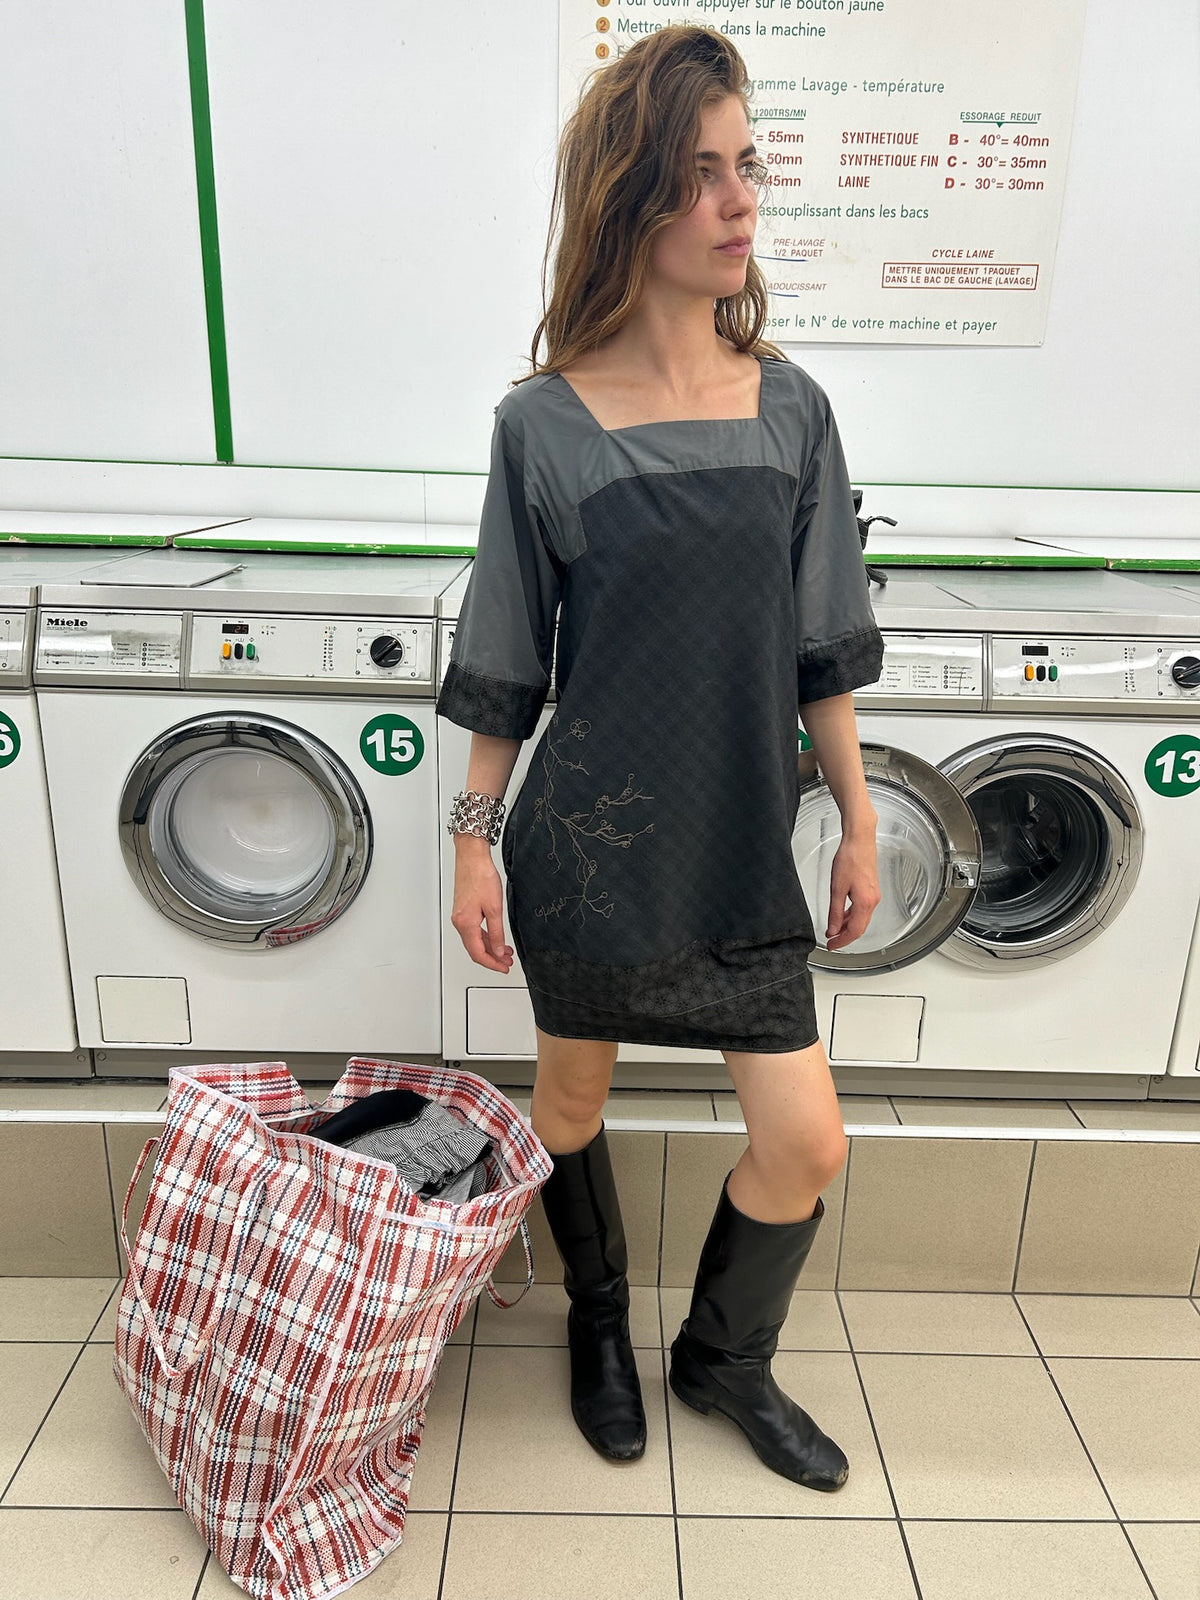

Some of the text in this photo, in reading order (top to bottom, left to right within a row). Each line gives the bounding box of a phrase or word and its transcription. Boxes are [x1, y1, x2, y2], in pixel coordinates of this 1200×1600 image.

[696, 0, 750, 13] appuyer
[755, 0, 775, 9] sur
[780, 0, 792, 10] le
[796, 0, 844, 10] bouton
[847, 0, 885, 15] jaune
[617, 18, 663, 34] Mettre
[720, 20, 751, 36] dans
[756, 20, 767, 36] la
[771, 21, 826, 37] machine
[802, 77, 848, 95] Lavage
[862, 78, 945, 97] température
[960, 112, 1042, 122] ESSORAGE REDUIT
[768, 131, 804, 143] 55mn
[842, 131, 919, 145] SYNTHETIQUE
[949, 134, 959, 145] B
[1013, 134, 1050, 147] 40mn
[767, 153, 803, 165] 50mn
[840, 154, 917, 167] SYNTHETIQUE
[920, 155, 939, 167] FIN
[947, 156, 957, 168] C
[1010, 156, 1047, 169] 35mn
[766, 175, 801, 187] 45mn
[838, 176, 870, 188] LAINE
[945, 177, 955, 189] D
[1008, 178, 1044, 190] 30mn
[845, 204, 875, 218] dans
[879, 204, 896, 218] les
[900, 204, 929, 219] bacs
[773, 238, 826, 247] PRE-LAVAGE
[774, 249, 824, 257] 1/2 PAQUET
[932, 249, 995, 259] CYCLE LAINE
[889, 266, 922, 275] METTRE
[925, 267, 979, 275] UNIQUEMENT
[885, 275, 1034, 286] DANS LE BAC DE GAUCHE (LAVAGE)
[795, 314, 806, 327] le
[811, 314, 827, 328] N°
[832, 315, 847, 328] de
[852, 318, 884, 329] votre
[889, 316, 940, 330] machine
[945, 319, 957, 331] et
[962, 321, 998, 335] payer
[46, 618, 88, 627] Miele
[366, 728, 416, 763] 15
[1155, 750, 1200, 784] 13
